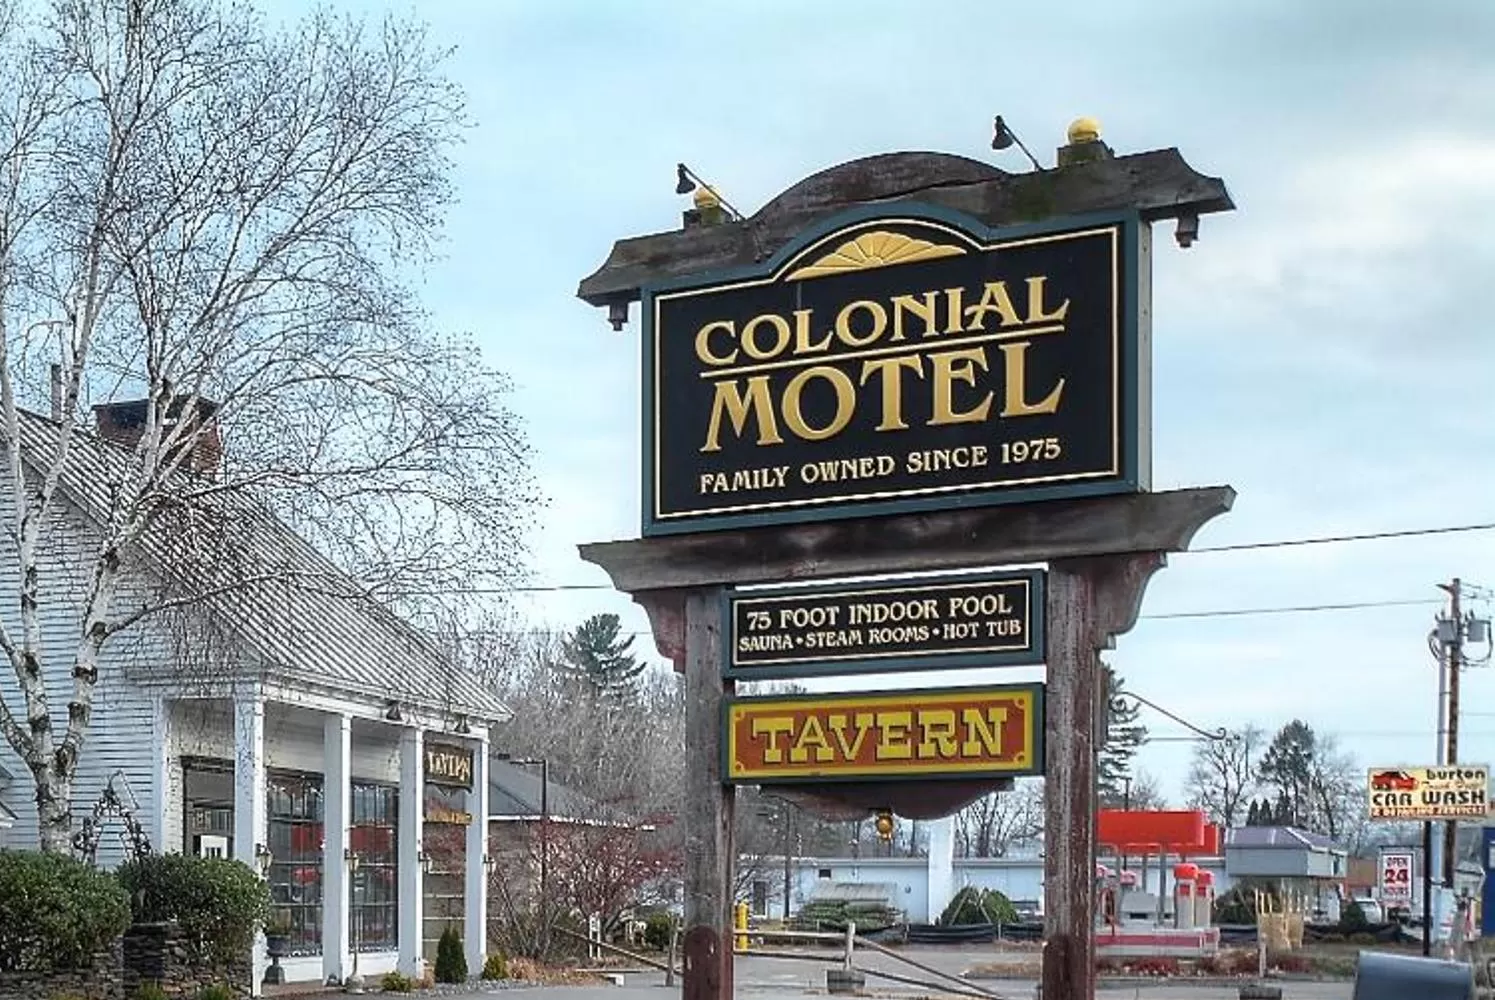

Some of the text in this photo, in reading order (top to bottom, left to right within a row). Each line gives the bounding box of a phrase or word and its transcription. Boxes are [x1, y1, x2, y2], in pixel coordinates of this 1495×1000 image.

[694, 275, 1071, 367] COLONIAL
[699, 341, 1066, 453] MOTEL
[699, 437, 1062, 495] FAMILY OWNED SINCE 1975
[738, 619, 1022, 652] SAUNA STEAM ROOMS HOT TUB
[746, 593, 1013, 631] 75 FOOT INDOOR POOL
[751, 706, 1008, 764] TAVERN
[1372, 789, 1485, 806] CAR WASH
